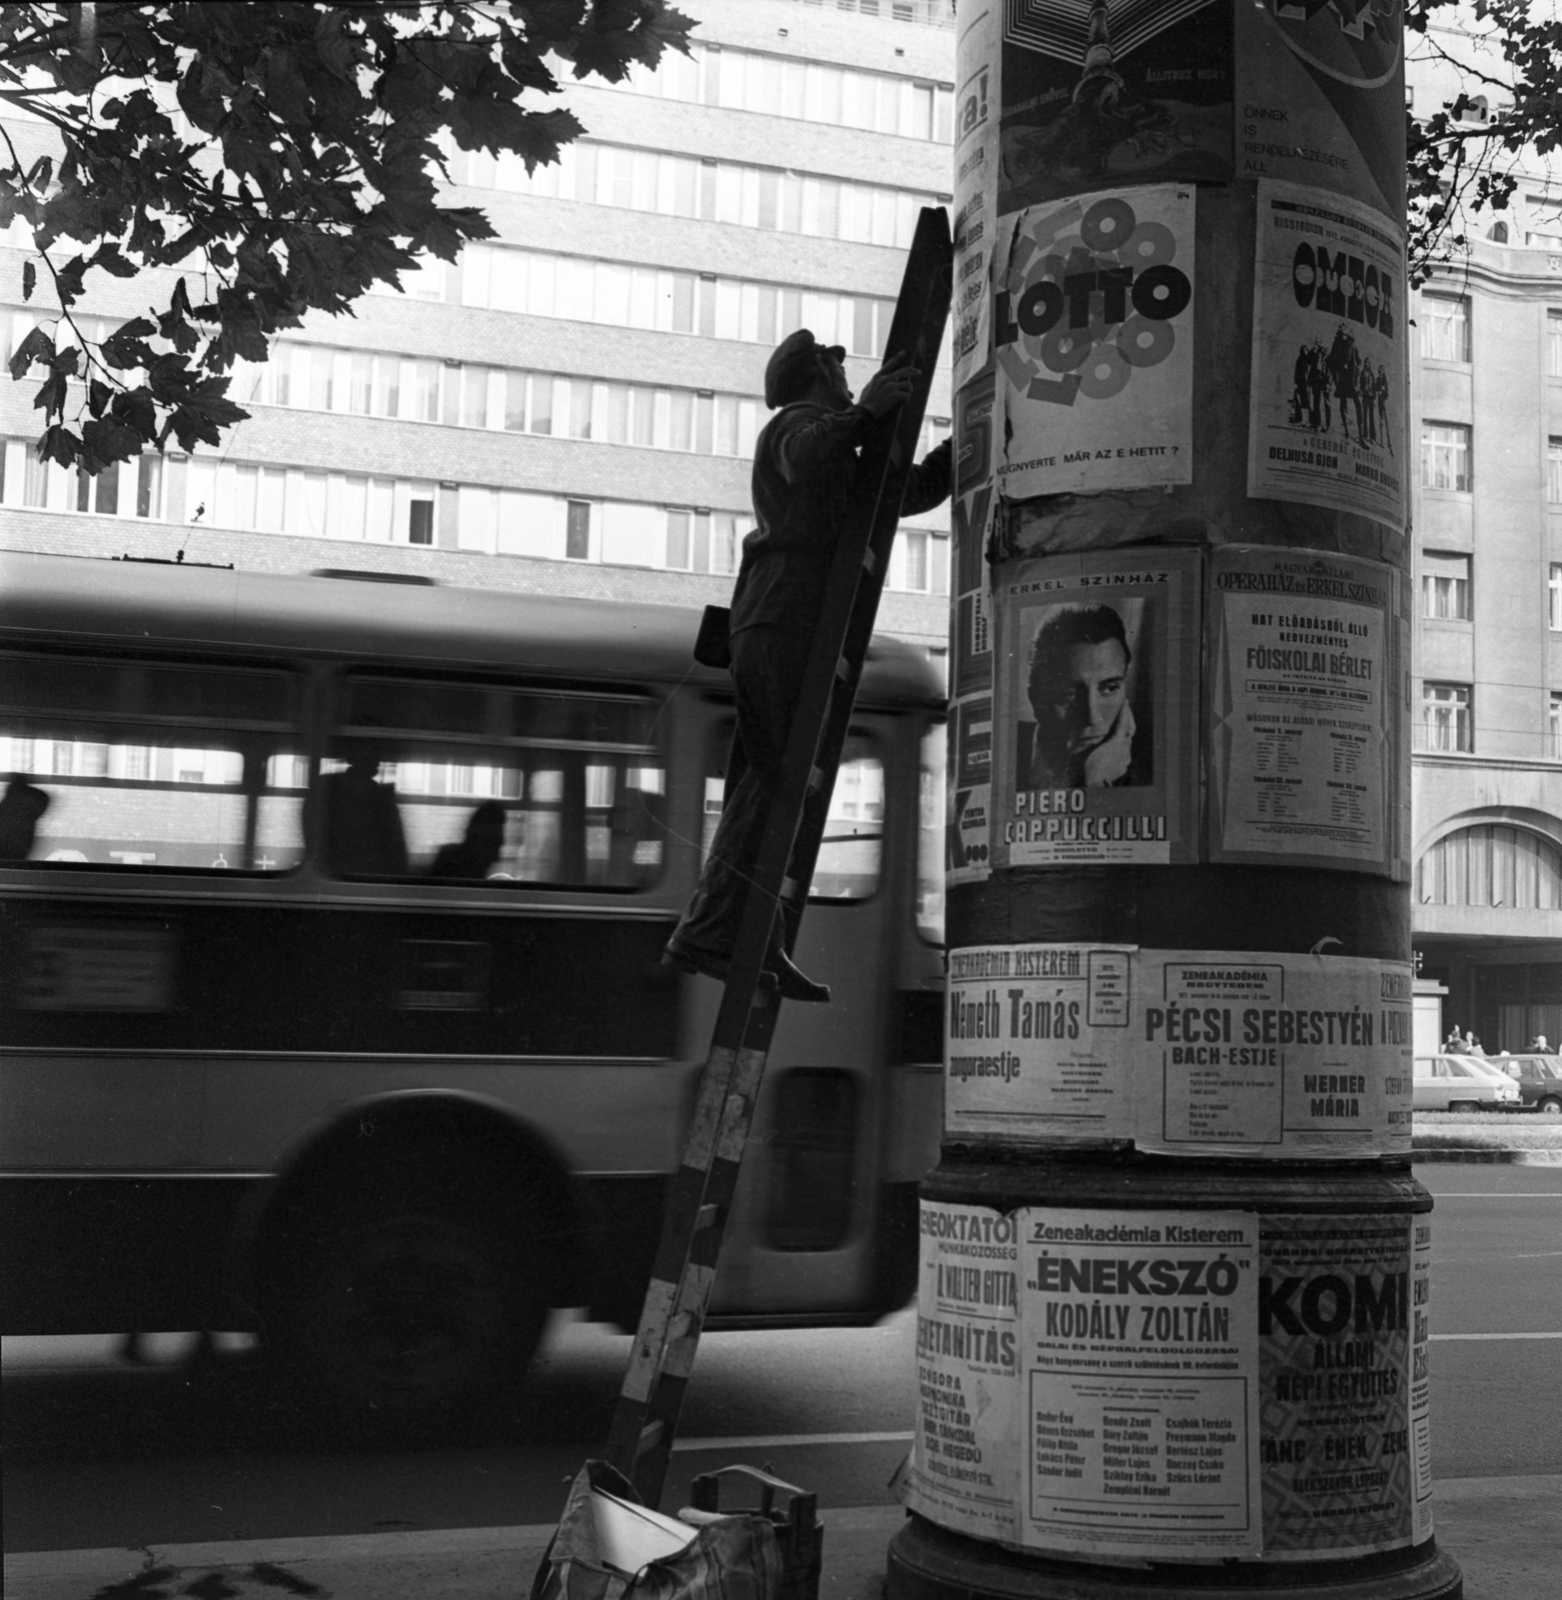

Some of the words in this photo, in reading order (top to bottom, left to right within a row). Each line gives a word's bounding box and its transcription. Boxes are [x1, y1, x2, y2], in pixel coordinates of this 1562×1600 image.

[1244, 124, 1258, 136] IS
[1292, 242, 1394, 341] OMEGA
[995, 263, 1193, 349] LOTTO
[1094, 447, 1113, 464] AZ
[1116, 446, 1126, 461] E
[1129, 442, 1168, 460] HETIT
[1269, 446, 1315, 466] DELHUSA
[1009, 579, 1065, 596] ERKEL
[1216, 571, 1295, 592] OPERAHÁZ
[1306, 576, 1349, 600] ERKEL
[1251, 613, 1274, 626] HAT
[1279, 631, 1350, 649] KEDVEZMÉNYES
[1246, 644, 1327, 674] FŐISKOLAI
[1329, 651, 1373, 680] BÉRLET
[1014, 789, 1087, 817] PIERO
[1004, 815, 1168, 845] CAPPUCCILLI
[1014, 950, 1081, 976] KISTEREM
[1181, 970, 1269, 982] ZENEAKADÉMIA
[1186, 980, 1265, 990] NAGYTEREM
[1007, 988, 1081, 1041] Tamás
[1144, 1000, 1232, 1044] PÉCSI
[1242, 1004, 1374, 1047] SEBESTYÉN
[1171, 1046, 1278, 1067] BACH-ESTJE
[1303, 1074, 1366, 1094] WERNER
[1311, 1094, 1360, 1118] MÁRIA
[1033, 1222, 1161, 1243] Zeneakadémia
[1164, 1225, 1244, 1244] Kisterem
[1258, 1271, 1408, 1337] KOMI
[1045, 1299, 1131, 1341] KODÁLY
[1140, 1302, 1230, 1343] ZOLTÁN
[1324, 1434, 1369, 1462] ÉNEK
